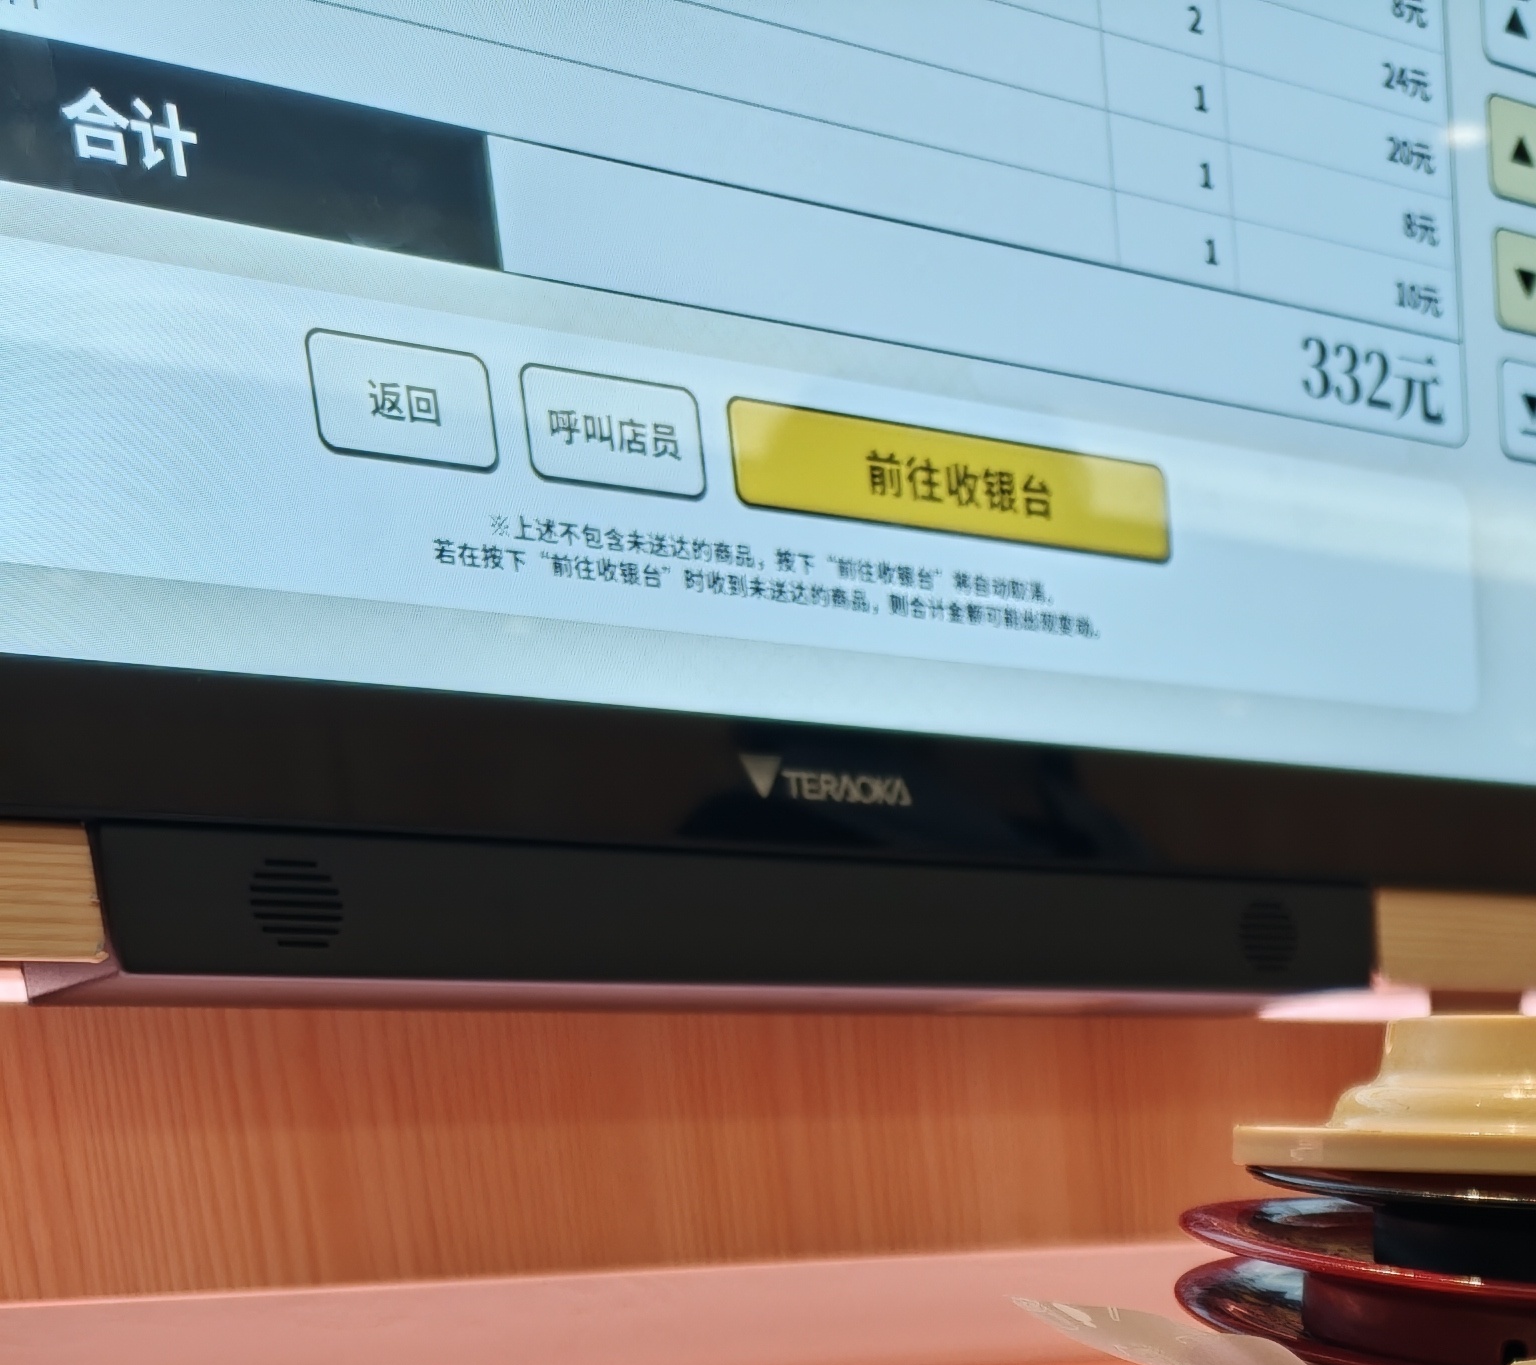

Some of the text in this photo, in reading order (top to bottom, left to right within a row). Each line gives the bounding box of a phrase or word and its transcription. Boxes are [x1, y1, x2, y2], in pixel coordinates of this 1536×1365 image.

[1187, 5, 1203, 35] 2
[1194, 85, 1208, 113] 1
[1382, 62, 1433, 102] 24元
[61, 87, 198, 178] 合计
[1386, 136, 1436, 176] 20元
[1200, 162, 1214, 190] 1
[1403, 212, 1441, 247] 8元
[1204, 239, 1218, 266] 1
[1396, 282, 1444, 318] 10元
[1302, 337, 1444, 426] 332元
[368, 378, 441, 427] 返回
[547, 406, 682, 463] 呼叫店员
[866, 450, 1053, 519] 前往收银台
[781, 767, 913, 806] TERAOKA
